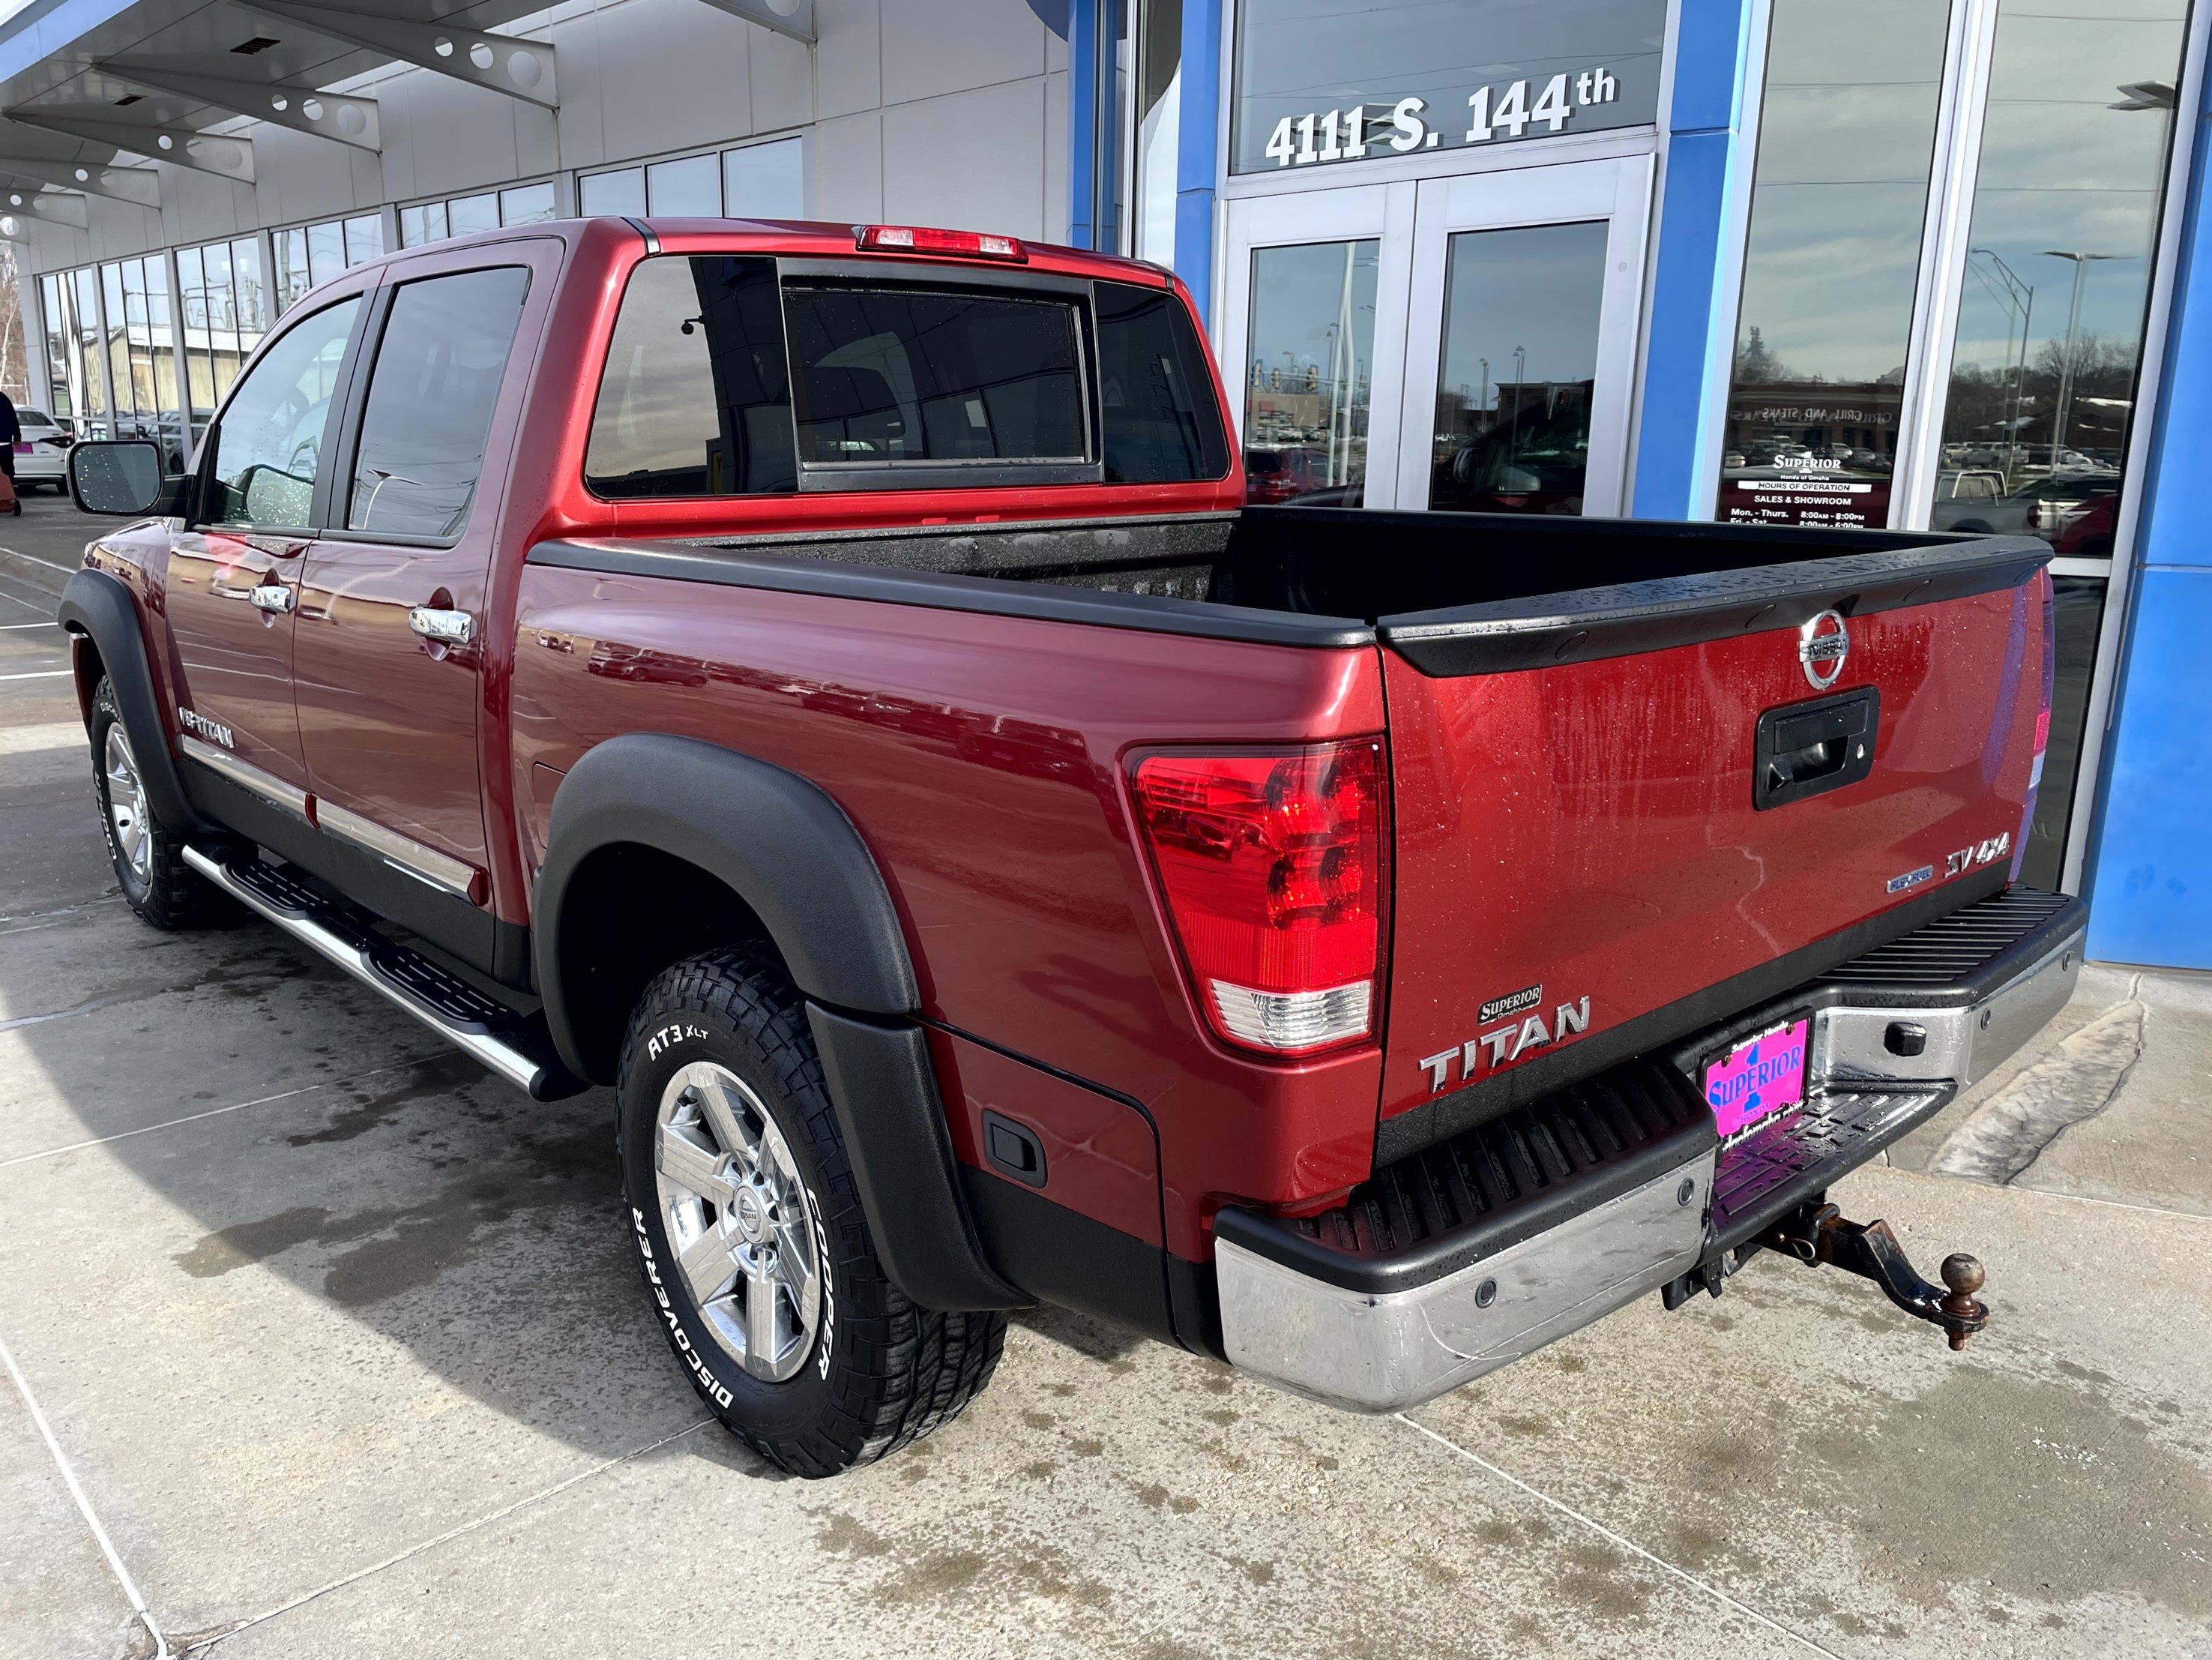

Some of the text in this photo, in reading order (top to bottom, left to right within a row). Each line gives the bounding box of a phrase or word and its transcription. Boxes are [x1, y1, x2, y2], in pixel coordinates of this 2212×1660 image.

[1265, 105, 1366, 166] 4111
[1390, 97, 1438, 151] S.
[1731, 508, 1753, 517] Mon.
[1762, 509, 1789, 518] Thurs.
[1754, 495, 1851, 505] SALES & SHOWROOM
[195, 714, 235, 748] TITAN
[1943, 846, 1974, 878] SV
[1480, 987, 1540, 1020] SUPERIOR
[648, 1024, 708, 1062] AT3 XLT
[1419, 996, 1590, 1093] TITAN
[1708, 1045, 1802, 1116] SUPERIOR
[806, 1188, 834, 1382] COOPER
[631, 1206, 734, 1410] DISCOVERER
